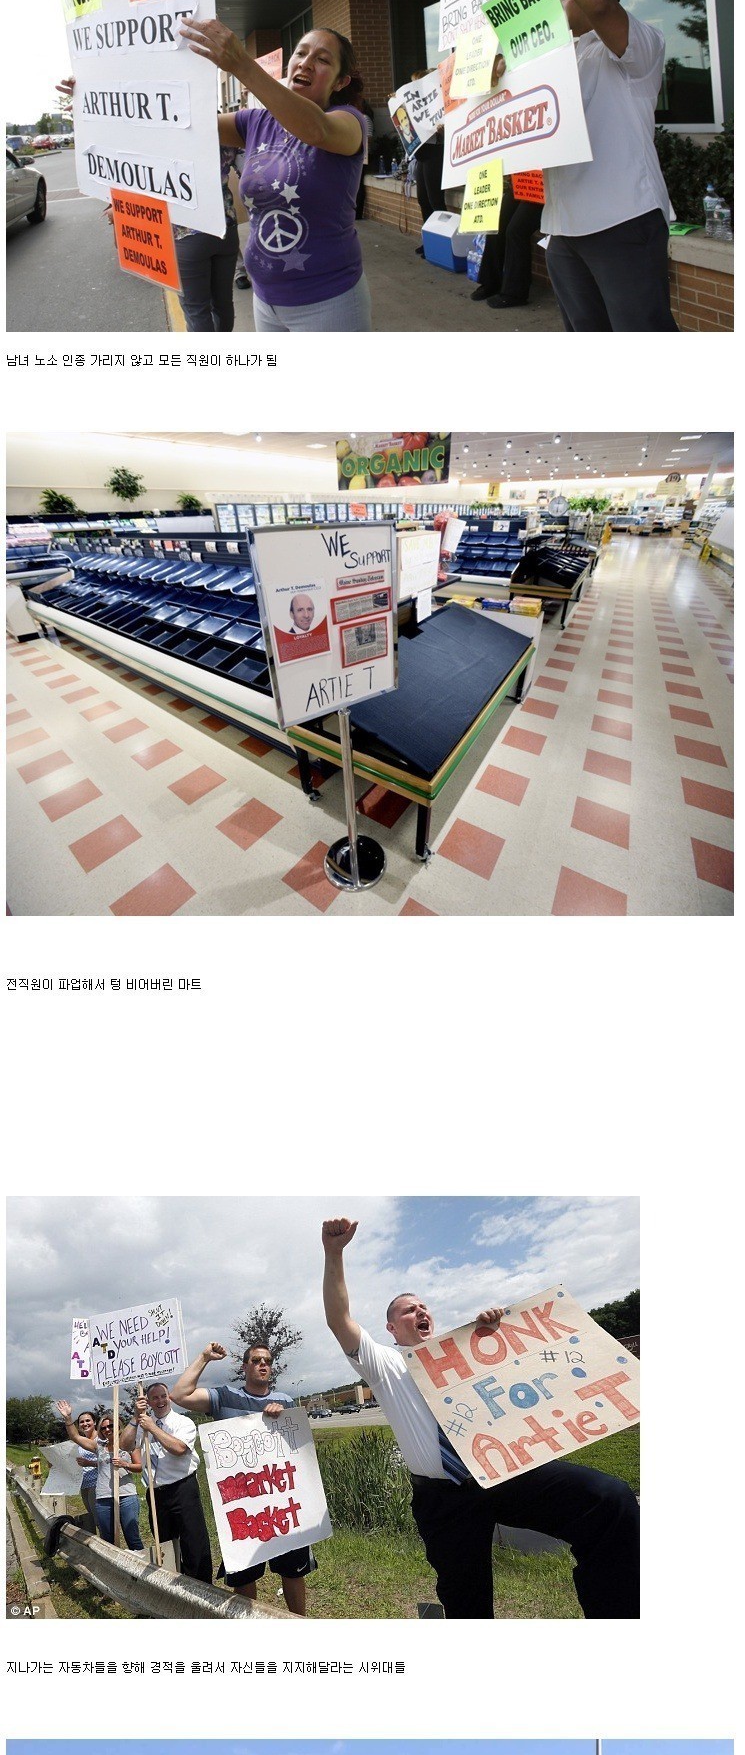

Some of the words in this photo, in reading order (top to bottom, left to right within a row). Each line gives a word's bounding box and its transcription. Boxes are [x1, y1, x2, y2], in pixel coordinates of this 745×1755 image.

[73, 26, 92, 51] WE
[510, 32, 530, 59] OUR
[531, 19, 555, 46] CEO.
[82, 91, 151, 120] ARTHUR
[156, 93, 178, 122] T.
[452, 127, 485, 161] MARKET
[486, 101, 548, 143] BASKET
[87, 152, 193, 202] DEMOULAS
[473, 184, 491, 196] LEADER
[113, 198, 125, 215] WE
[125, 200, 163, 225] SUPPORT
[121, 224, 153, 245] ARTHUR
[124, 248, 168, 276] DEMOULAS
[341, 446, 445, 477] ORGANIC
[321, 531, 351, 557] WE
[306, 673, 353, 712] ARTIE
[363, 666, 375, 690] T
[96, 1321, 115, 1341] WE
[120, 1316, 148, 1337] NEED
[113, 1336, 139, 1358] YOUR
[141, 1327, 170, 1344] HELP!
[415, 1301, 579, 1389] HONK
[97, 1357, 136, 1385] PLEASE
[140, 1348, 180, 1374] BOYCOTT
[472, 1372, 558, 1419] For
[472, 1409, 608, 1480] Artie
[574, 1371, 640, 1421] T
